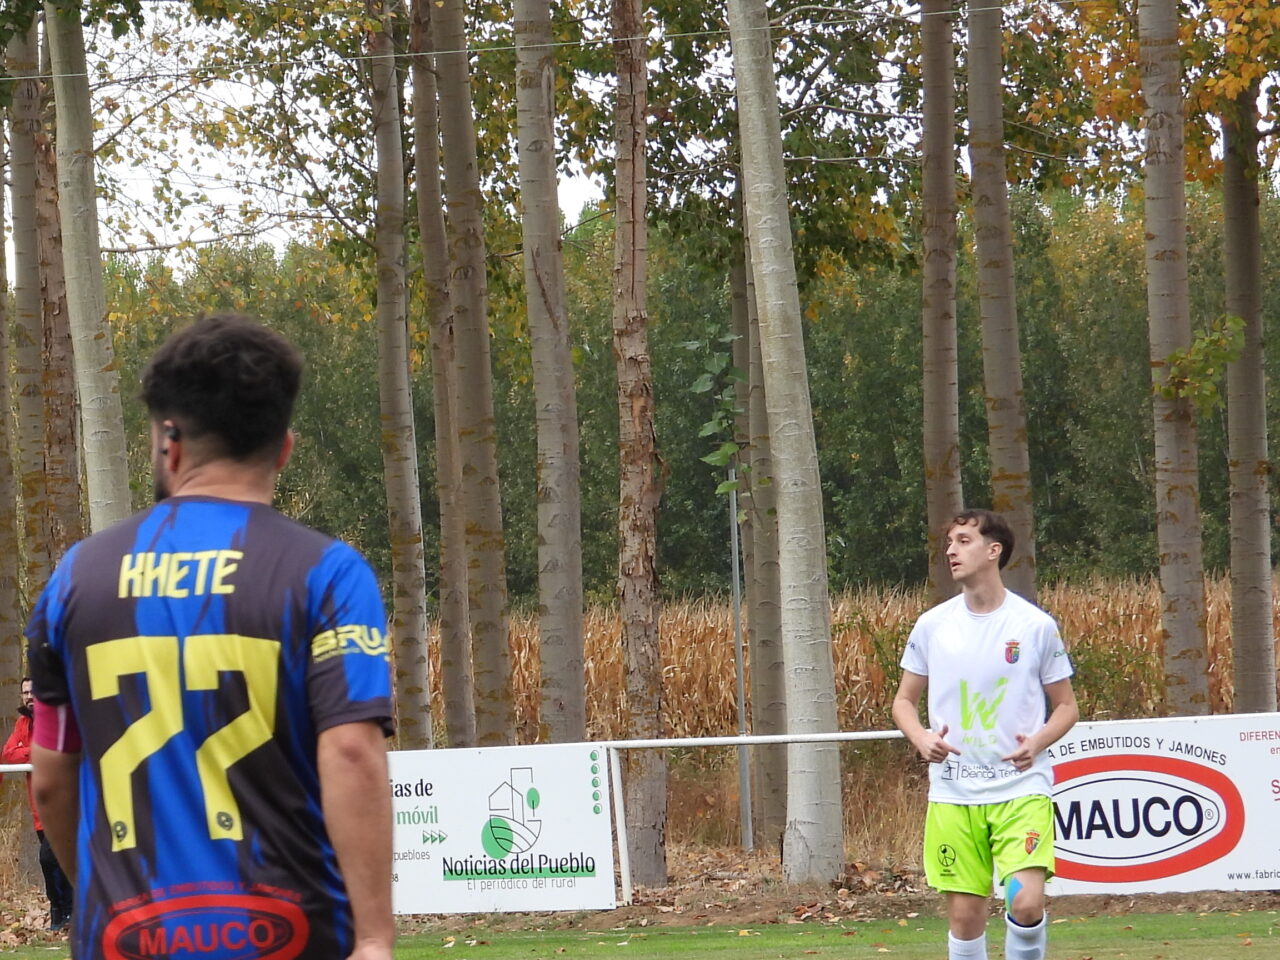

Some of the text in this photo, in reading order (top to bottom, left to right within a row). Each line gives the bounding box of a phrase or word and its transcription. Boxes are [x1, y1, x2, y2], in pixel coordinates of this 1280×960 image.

[86, 634, 281, 852] 77
[1060, 742, 1075, 757] DE
[1081, 736, 1150, 752] EMBUTIDOS
[1157, 738, 1164, 750] Y
[1169, 740, 1227, 766] JAMONES
[415, 778, 433, 797] de
[396, 805, 439, 825] móvil
[1052, 795, 1204, 841] MAUCO
[442, 851, 596, 877] Noticias del Pueblo
[467, 875, 576, 892] El periódico del rural
[138, 919, 275, 956] MAUCO
